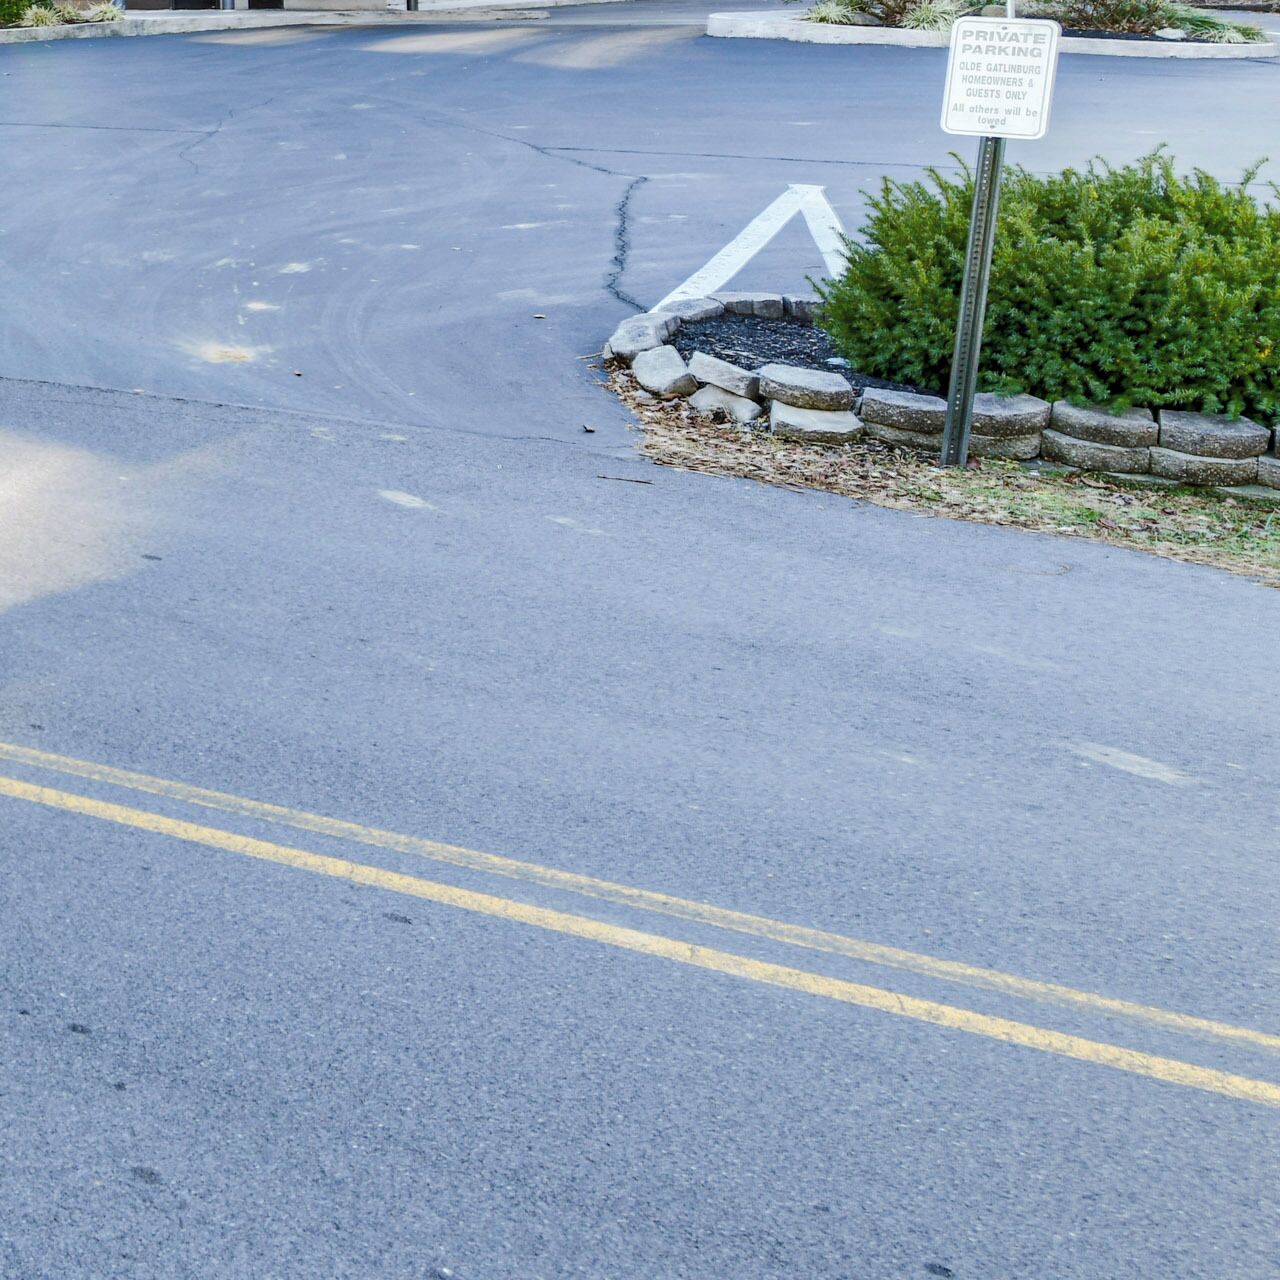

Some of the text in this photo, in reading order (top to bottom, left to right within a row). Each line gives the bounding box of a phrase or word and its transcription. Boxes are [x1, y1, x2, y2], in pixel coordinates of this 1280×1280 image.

[961, 30, 1047, 44] PRIVATE
[961, 44, 1042, 58] PARKING
[959, 62, 1041, 75] OLDE GATLINBURG
[961, 75, 1023, 87] HOMEOWNERS
[966, 88, 1028, 100] GUESTS ONLY
[952, 103, 1038, 117] All others will be
[977, 116, 1007, 126] towed
